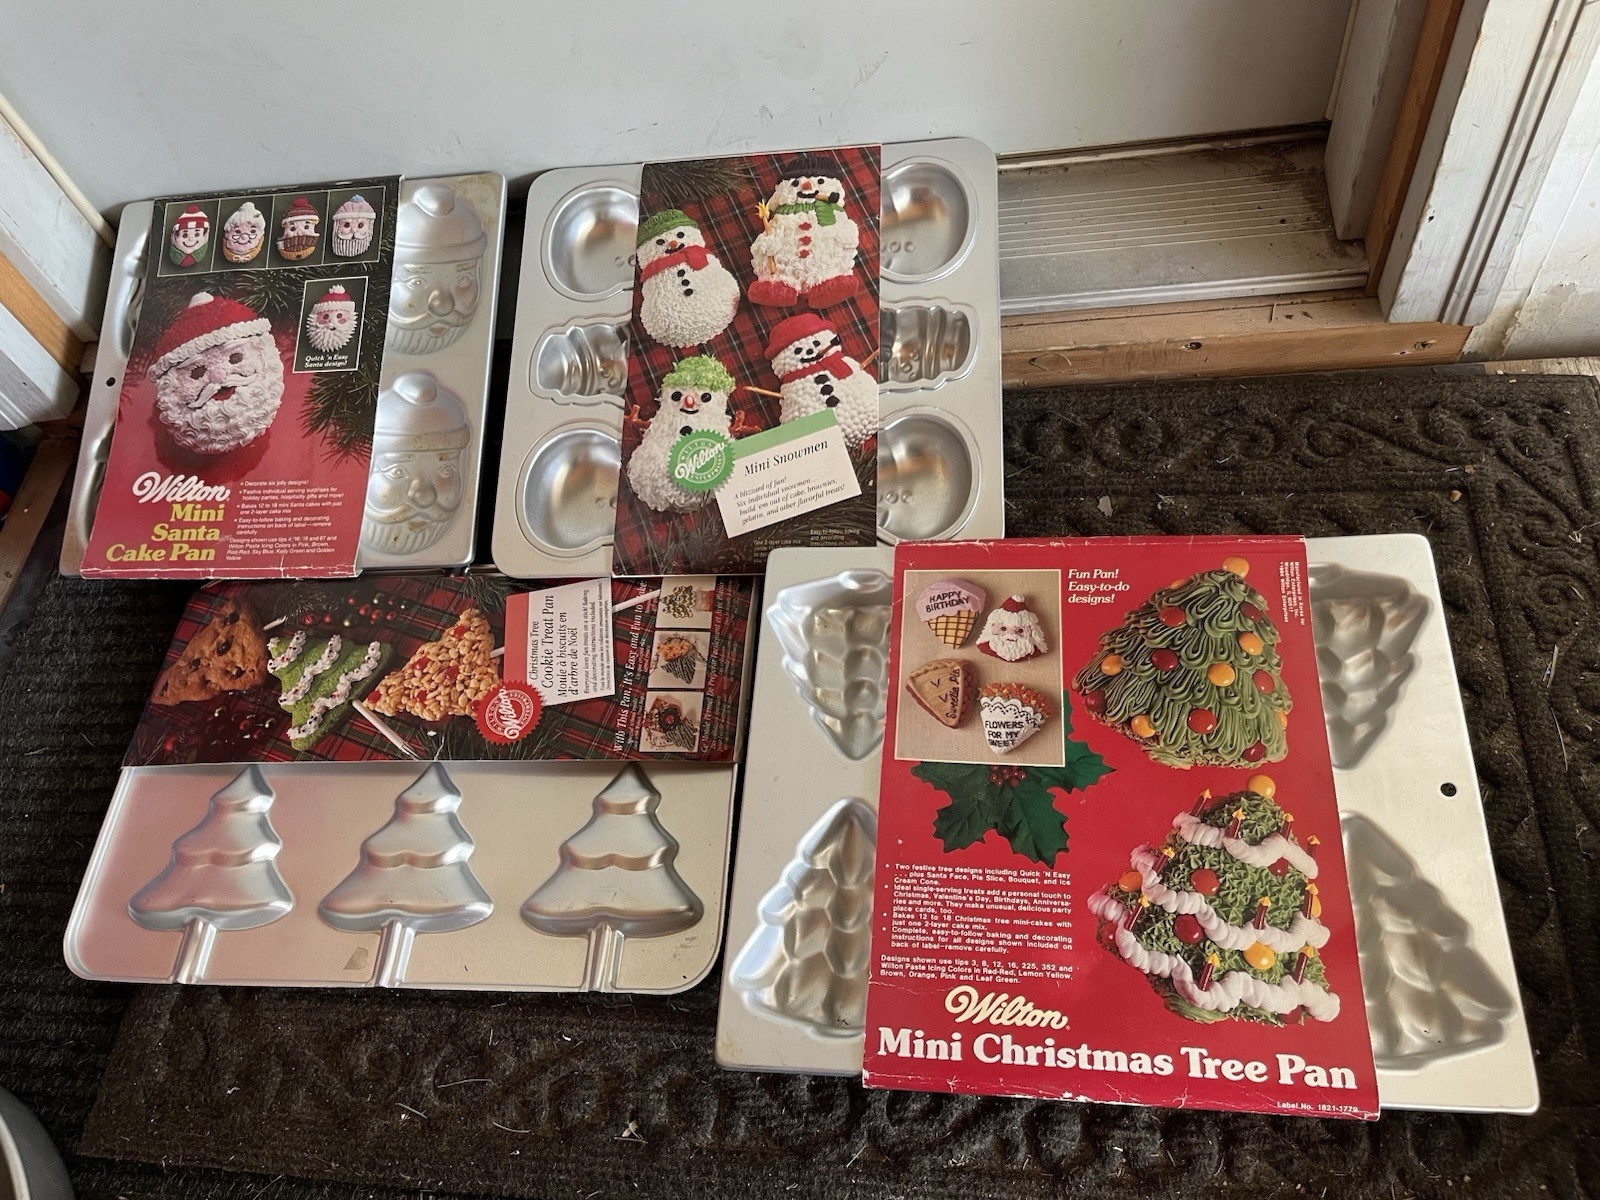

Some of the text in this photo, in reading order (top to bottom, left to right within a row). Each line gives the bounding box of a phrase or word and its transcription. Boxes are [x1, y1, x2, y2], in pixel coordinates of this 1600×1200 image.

[675, 442, 724, 479] Wilton
[744, 458, 770, 476] Mini
[773, 440, 828, 466] Snowmen
[132, 471, 231, 503] Wilton
[737, 478, 811, 508] Six individual snowmen
[170, 504, 225, 522] Mini
[151, 523, 220, 541] Santa
[106, 543, 215, 562] Cake Pan
[1068, 569, 1119, 578] Fun Pan!
[636, 580, 647, 598] ake:
[1068, 581, 1130, 593] Easy-to-do
[926, 596, 970, 612] BIRTHDAY
[930, 591, 961, 603] HAPPY
[1068, 594, 1115, 605] designs!
[560, 612, 567, 622] en
[634, 604, 643, 612] to
[631, 614, 642, 630] Fun
[541, 595, 554, 688] Cookie Treat Pan
[557, 626, 567, 659] biscuits
[630, 631, 639, 649] and
[529, 621, 539, 680] Christmas Tree
[568, 628, 578, 695] d'arbre de Noël
[625, 650, 638, 670] Easy
[557, 671, 567, 697] Moule
[623, 671, 634, 685] It's
[499, 689, 522, 739] Wilton
[616, 709, 628, 727] This
[985, 721, 1024, 729] FLOWERS
[614, 730, 625, 751] With
[894, 876, 917, 884] Cream
[895, 862, 910, 870] Two
[912, 863, 936, 871] festive
[955, 866, 982, 875] designs
[985, 867, 1017, 877] including
[1020, 869, 1040, 877] Quick
[1053, 871, 1070, 880] Easy
[909, 870, 924, 878] plus
[927, 871, 947, 879] Santa
[949, 872, 969, 881] Face,
[972, 873, 983, 881] Pie
[986, 874, 1005, 883] Slice,
[1008, 875, 1040, 884] Bouquet,
[893, 890, 1071, 907] Christmas, Valentine's Day, Birthdays, Anniversa-
[894, 883, 911, 891] Ideal
[913, 885, 961, 895] single-serving
[964, 887, 984, 895] treats
[1041, 891, 1061, 899] touch
[893, 905, 912, 913] place
[915, 906, 937, 914] cards,
[893, 911, 915, 919] Bakes
[955, 915, 991, 923] Christmas
[1013, 918, 1052, 926] mini-cakes
[892, 926, 928, 935] Complete,
[932, 929, 982, 938] easy-to-follow
[986, 931, 1011, 941] baking
[1032, 934, 1072, 944] decorating
[945, 985, 1069, 1030] Wilton
[877, 1026, 1358, 1090] Mini Christmas Tree Pan
[1277, 1101, 1298, 1109] Label
